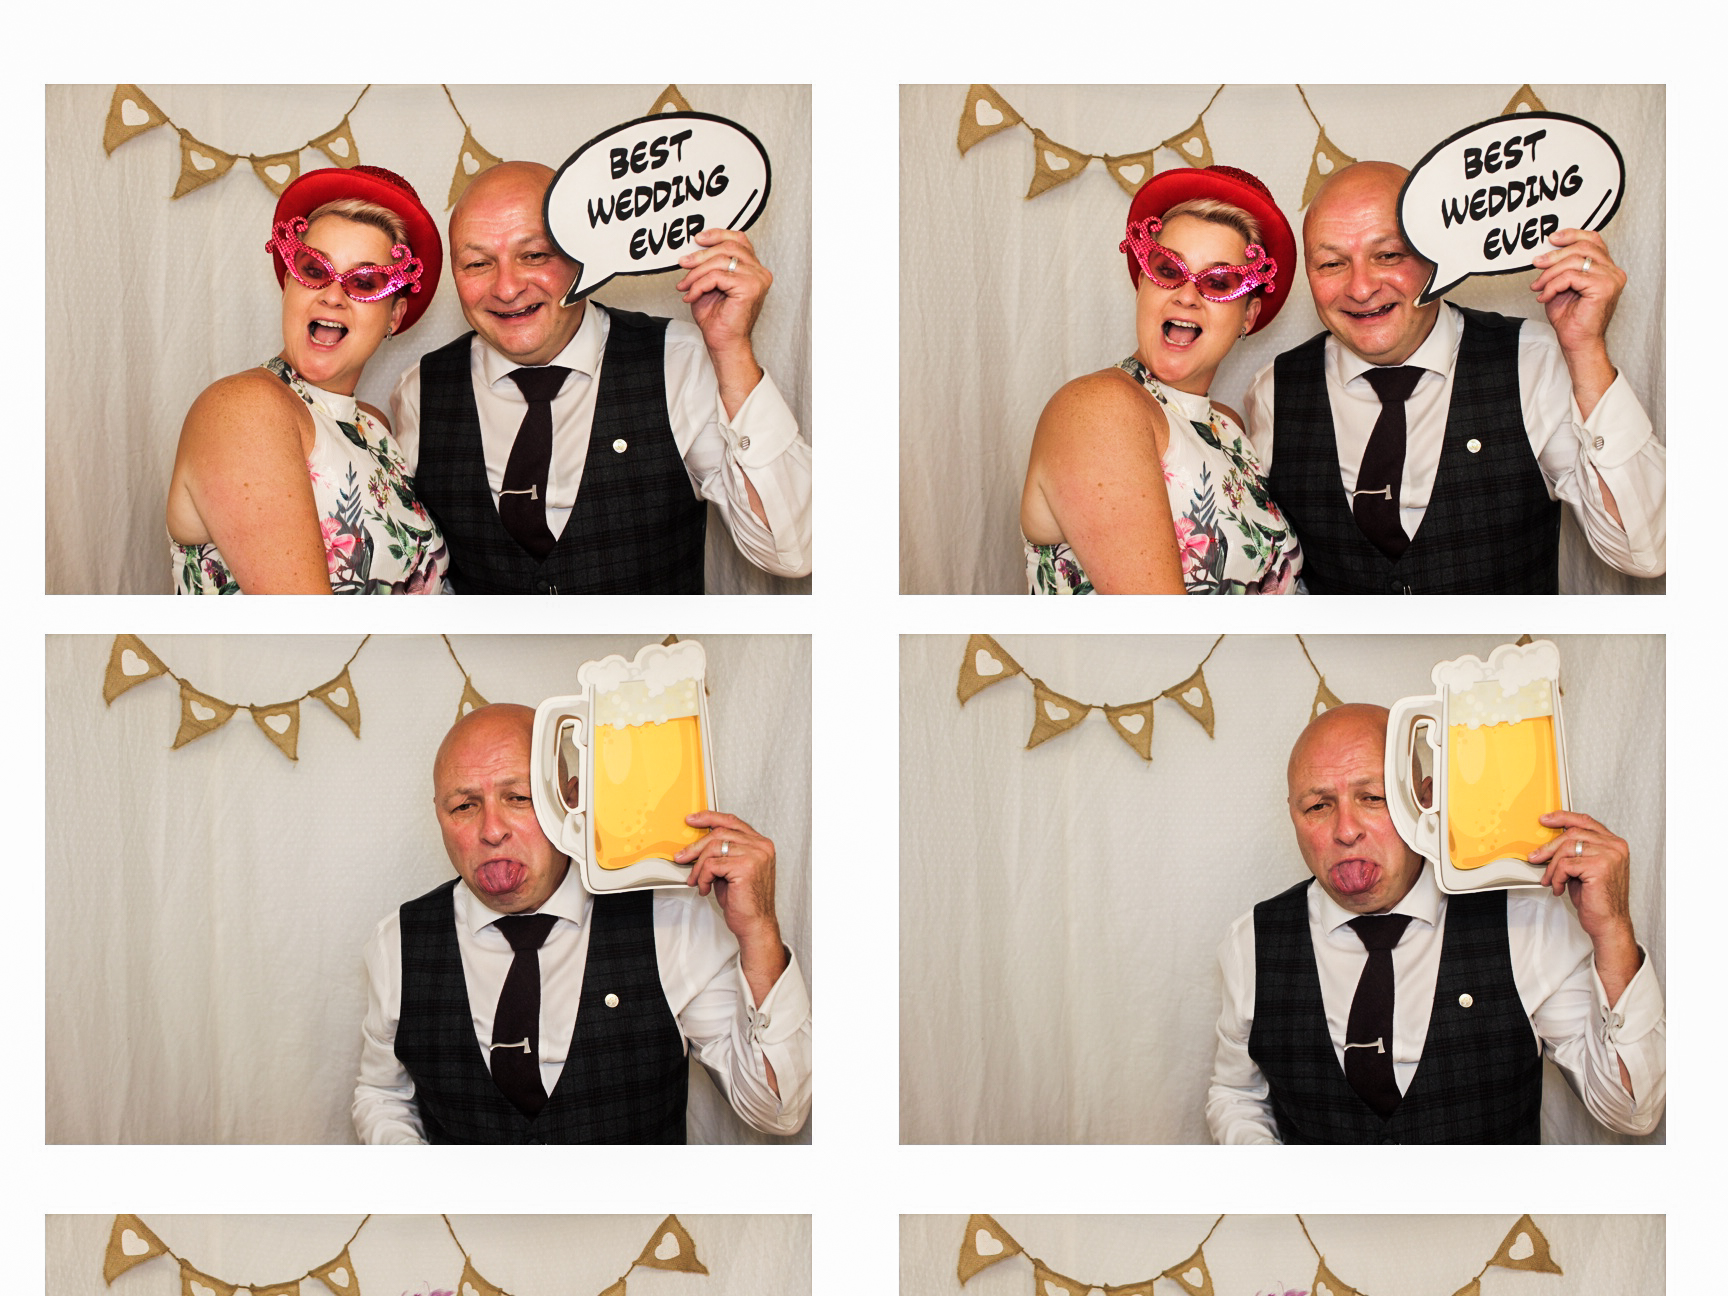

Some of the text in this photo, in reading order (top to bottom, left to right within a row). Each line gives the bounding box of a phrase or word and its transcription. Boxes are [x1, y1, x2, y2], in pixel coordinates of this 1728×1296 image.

[610, 129, 692, 180] BEST
[1464, 129, 1547, 180] BEST
[587, 164, 729, 229] WEDDING
[1442, 164, 1583, 229] WEDDING
[629, 213, 705, 260] EVER
[1483, 213, 1559, 260] EVER
